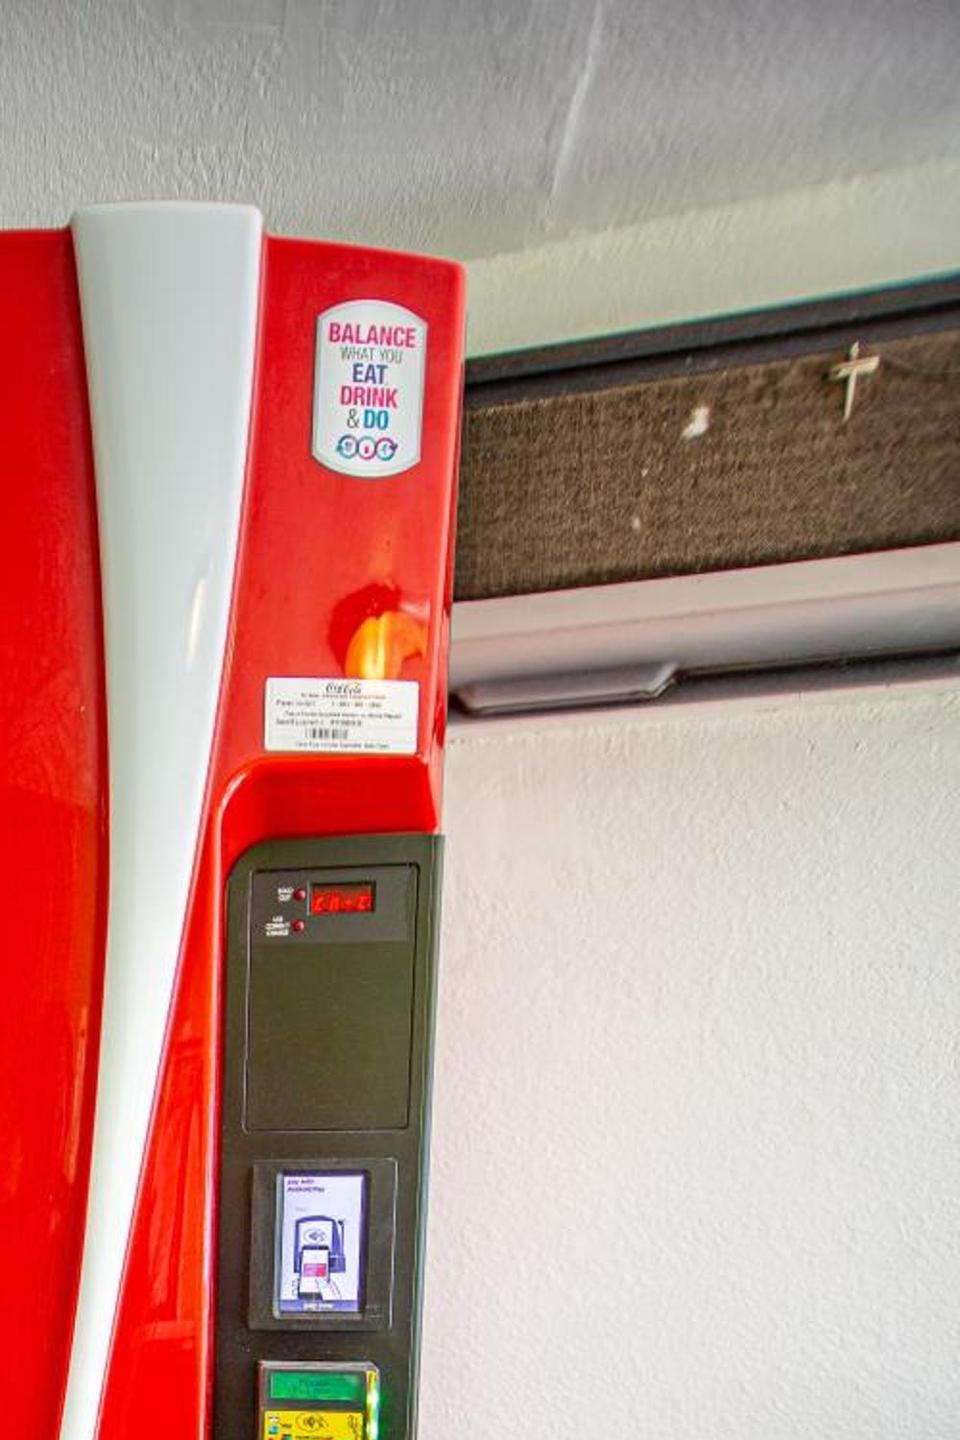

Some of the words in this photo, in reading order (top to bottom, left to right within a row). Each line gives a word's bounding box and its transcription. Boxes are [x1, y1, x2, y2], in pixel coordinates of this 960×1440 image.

[329, 322, 416, 348] BALANCE
[341, 347, 375, 361] WHAT
[380, 349, 402, 364] YOU
[352, 363, 387, 385] EAT
[340, 385, 398, 408] DRINK
[347, 409, 359, 429] &
[363, 409, 389, 430] DO
